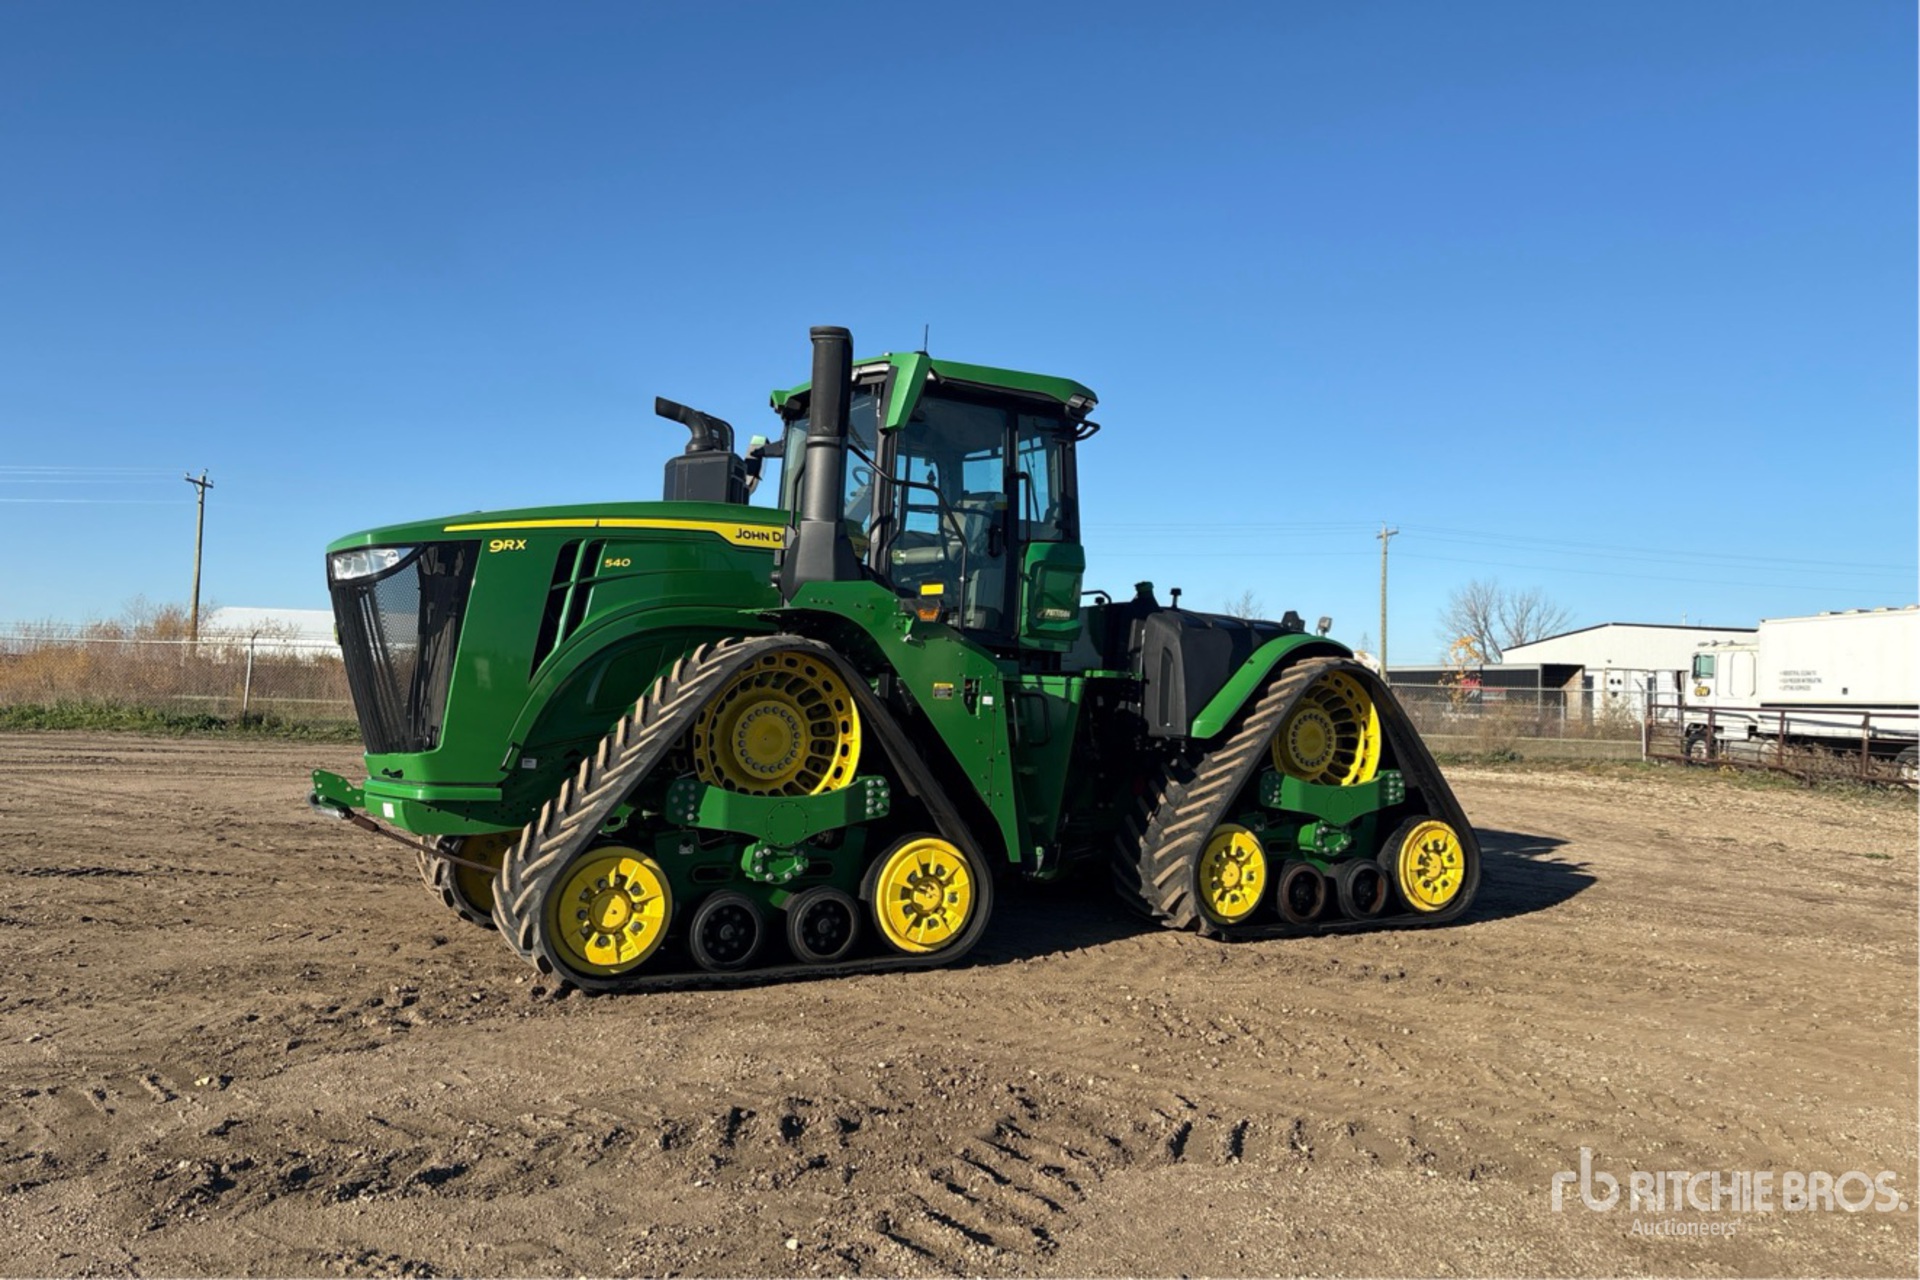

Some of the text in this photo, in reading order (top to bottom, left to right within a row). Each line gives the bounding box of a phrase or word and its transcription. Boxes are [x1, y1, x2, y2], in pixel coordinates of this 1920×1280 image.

[735, 527, 785, 543] JOHN D
[489, 539, 527, 553] 9RX
[604, 558, 631, 568] 540
